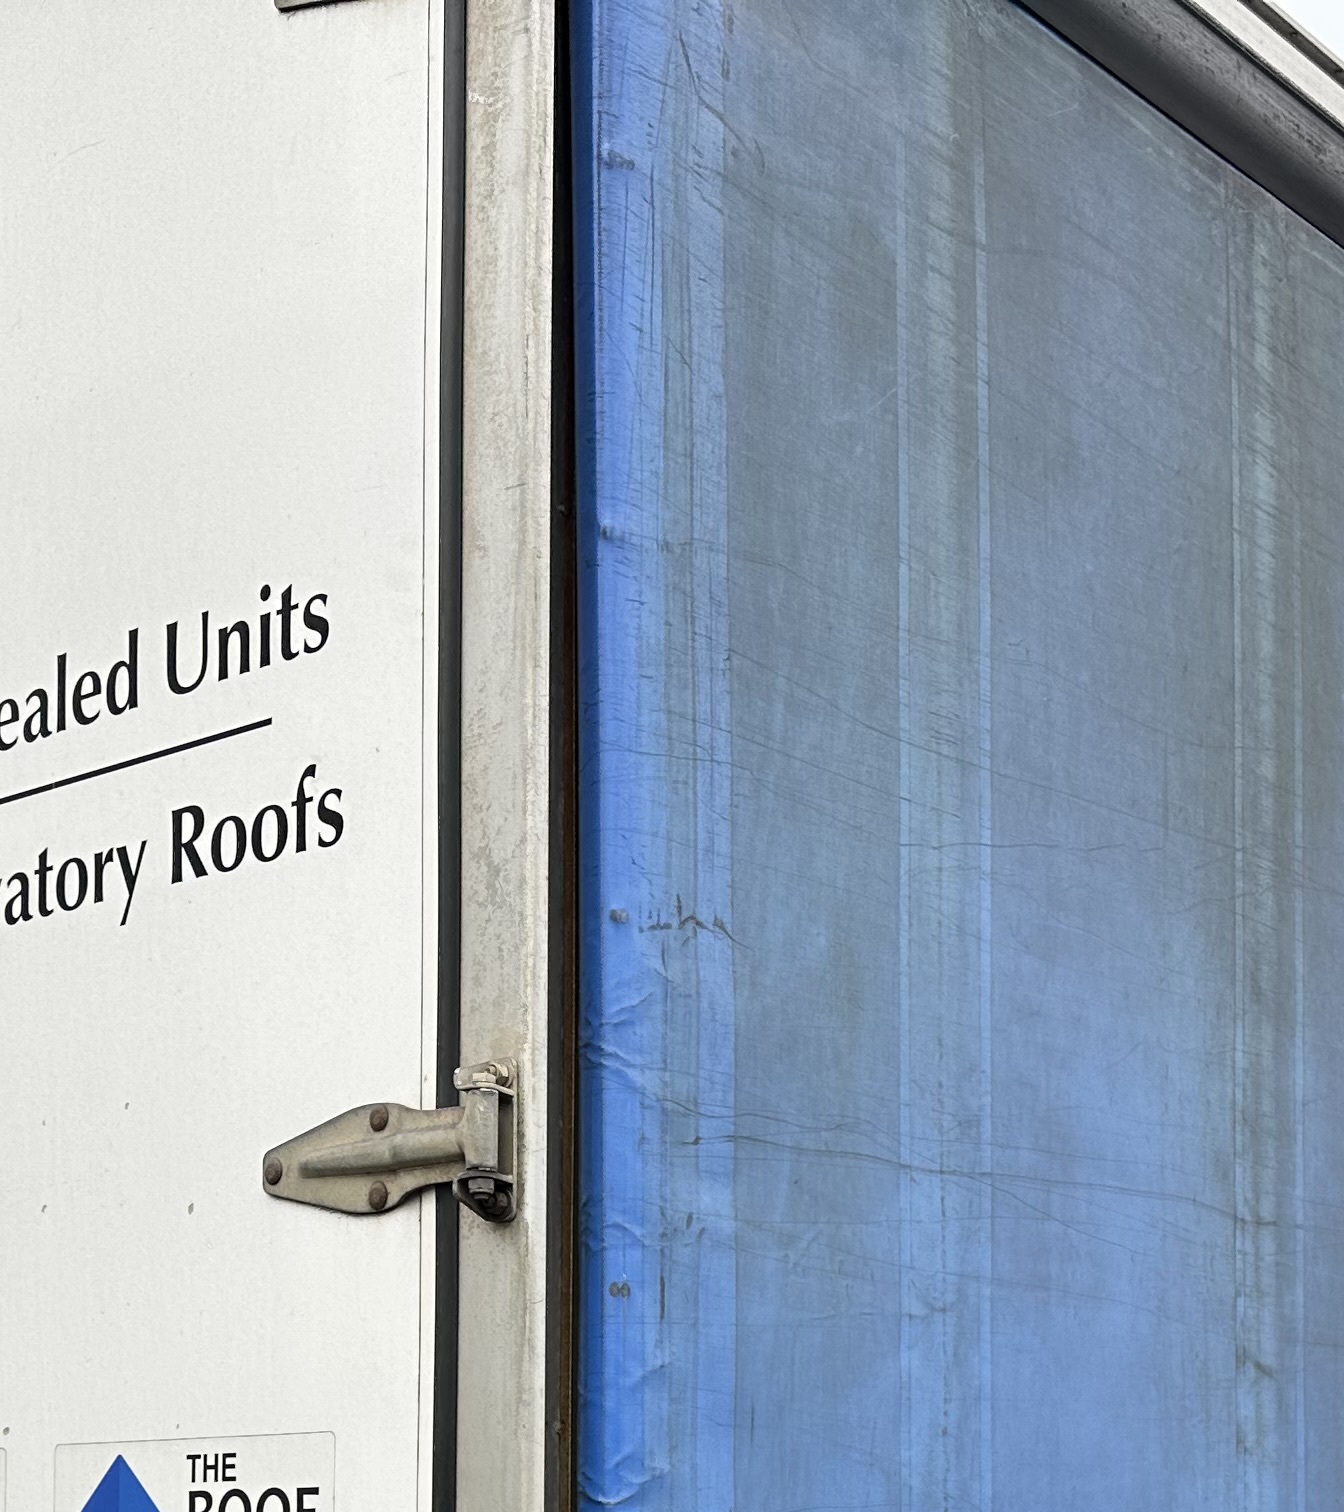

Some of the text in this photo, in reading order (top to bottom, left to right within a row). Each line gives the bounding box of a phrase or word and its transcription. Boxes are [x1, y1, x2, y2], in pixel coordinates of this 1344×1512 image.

[166, 583, 330, 695] Units
[171, 764, 345, 885] Roofs
[186, 1452, 238, 1483] THE
